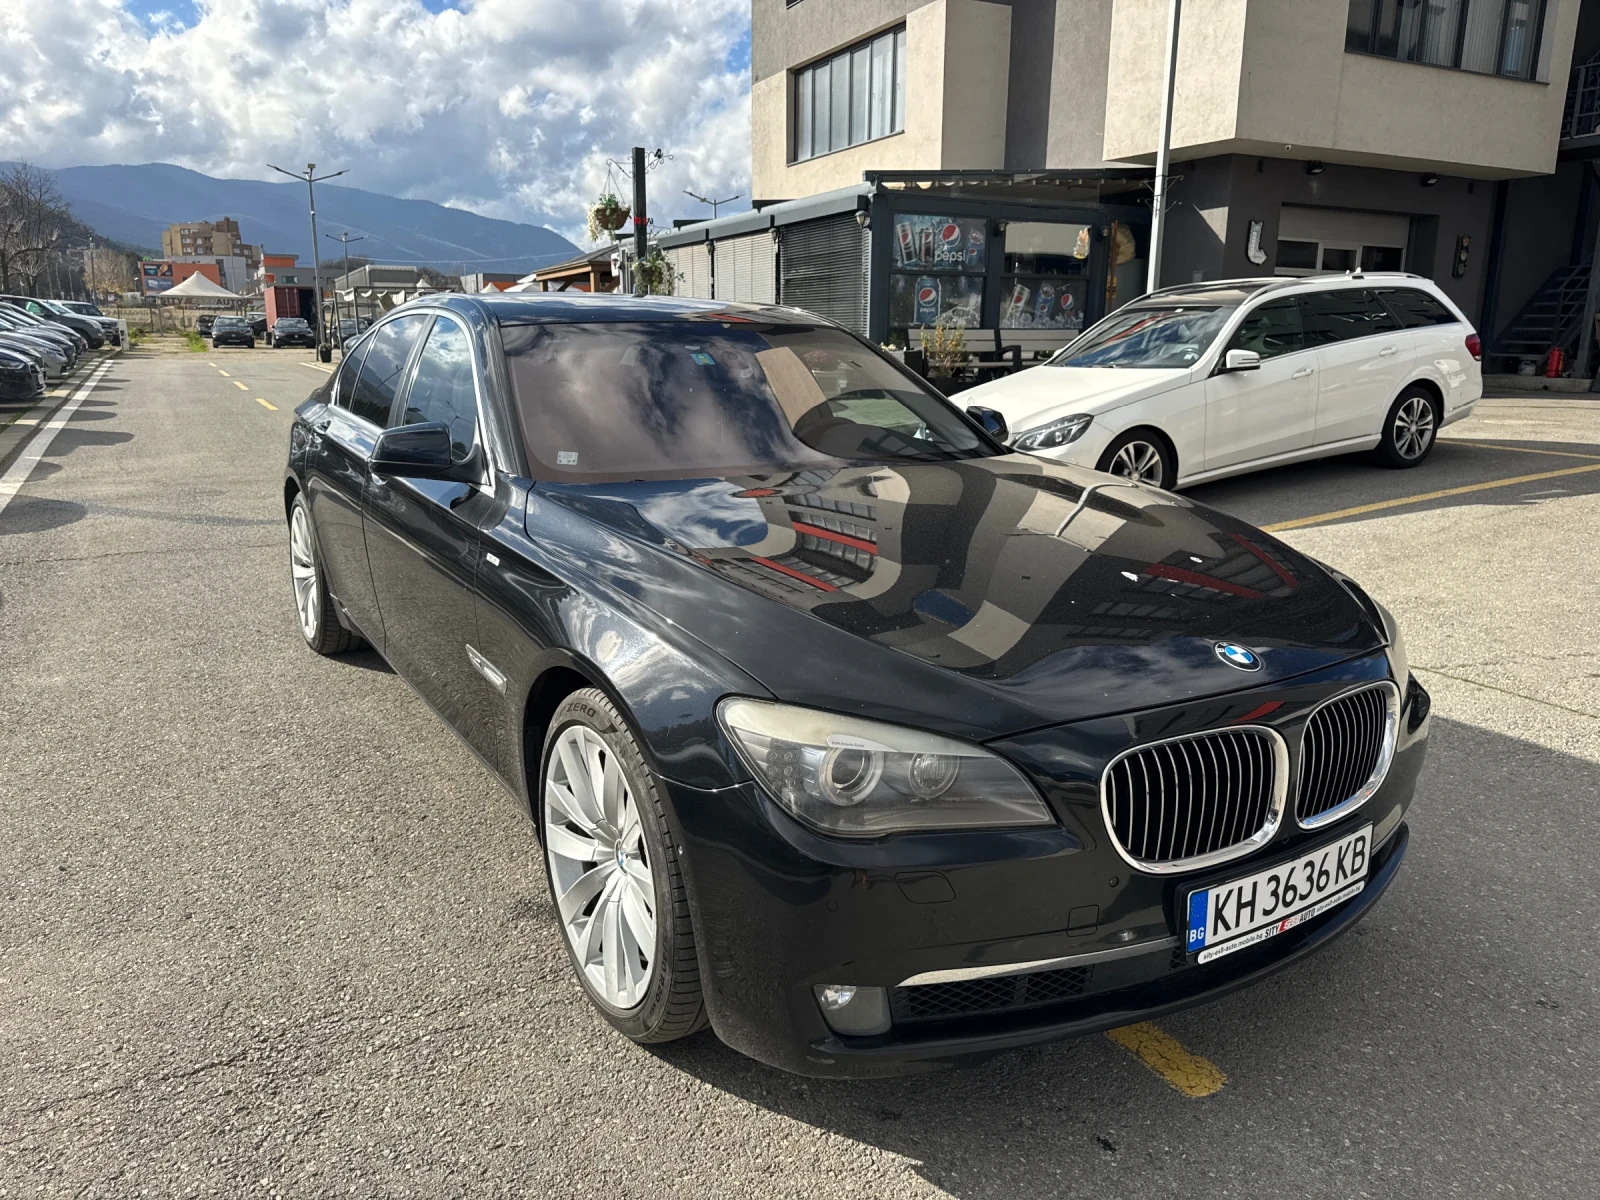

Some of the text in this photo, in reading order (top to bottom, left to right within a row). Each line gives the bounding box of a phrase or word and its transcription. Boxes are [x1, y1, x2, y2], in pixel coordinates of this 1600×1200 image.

[934, 250, 966, 263] pepsi
[160, 296, 183, 305] SITY
[216, 298, 244, 306] AUTO
[567, 702, 597, 718] ZERO
[1212, 834, 1366, 937] KH 3636 KB
[1264, 924, 1280, 938] SITY
[1299, 907, 1316, 923] AUTO
[1189, 926, 1205, 943] BG
